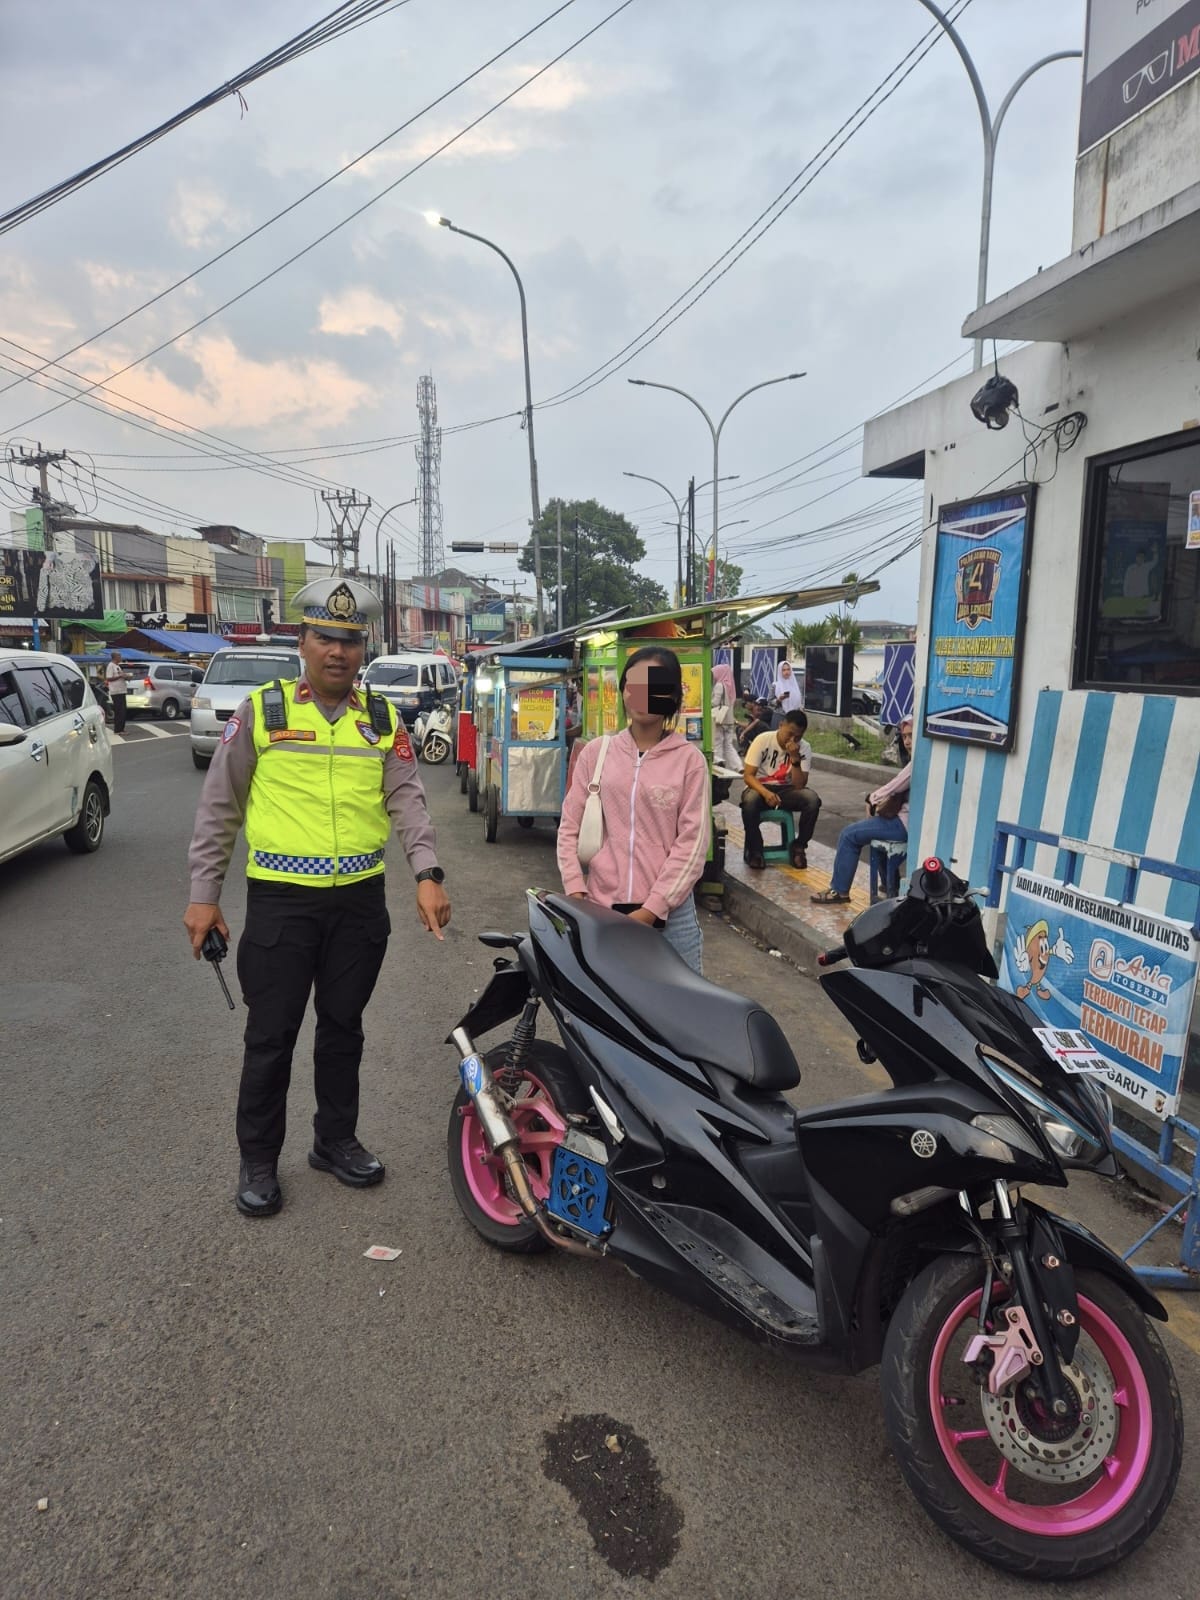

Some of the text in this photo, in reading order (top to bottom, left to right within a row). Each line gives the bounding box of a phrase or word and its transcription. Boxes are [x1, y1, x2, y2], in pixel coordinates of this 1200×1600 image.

[475, 614, 501, 626] APOTEK
[957, 637, 1015, 657] KARANGPAWITAN
[945, 660, 995, 677] POLRES GARUT
[1016, 875, 1190, 951] JADILAH PELOPOR KESELAMATAN LALU LINTAS
[1115, 955, 1172, 991] Asia
[1115, 974, 1166, 1003] TOSERBA
[1084, 979, 1167, 1035] TERBUKTI TETAP
[1080, 1002, 1164, 1073] TERMURAH
[1107, 1069, 1148, 1100] GARUT
